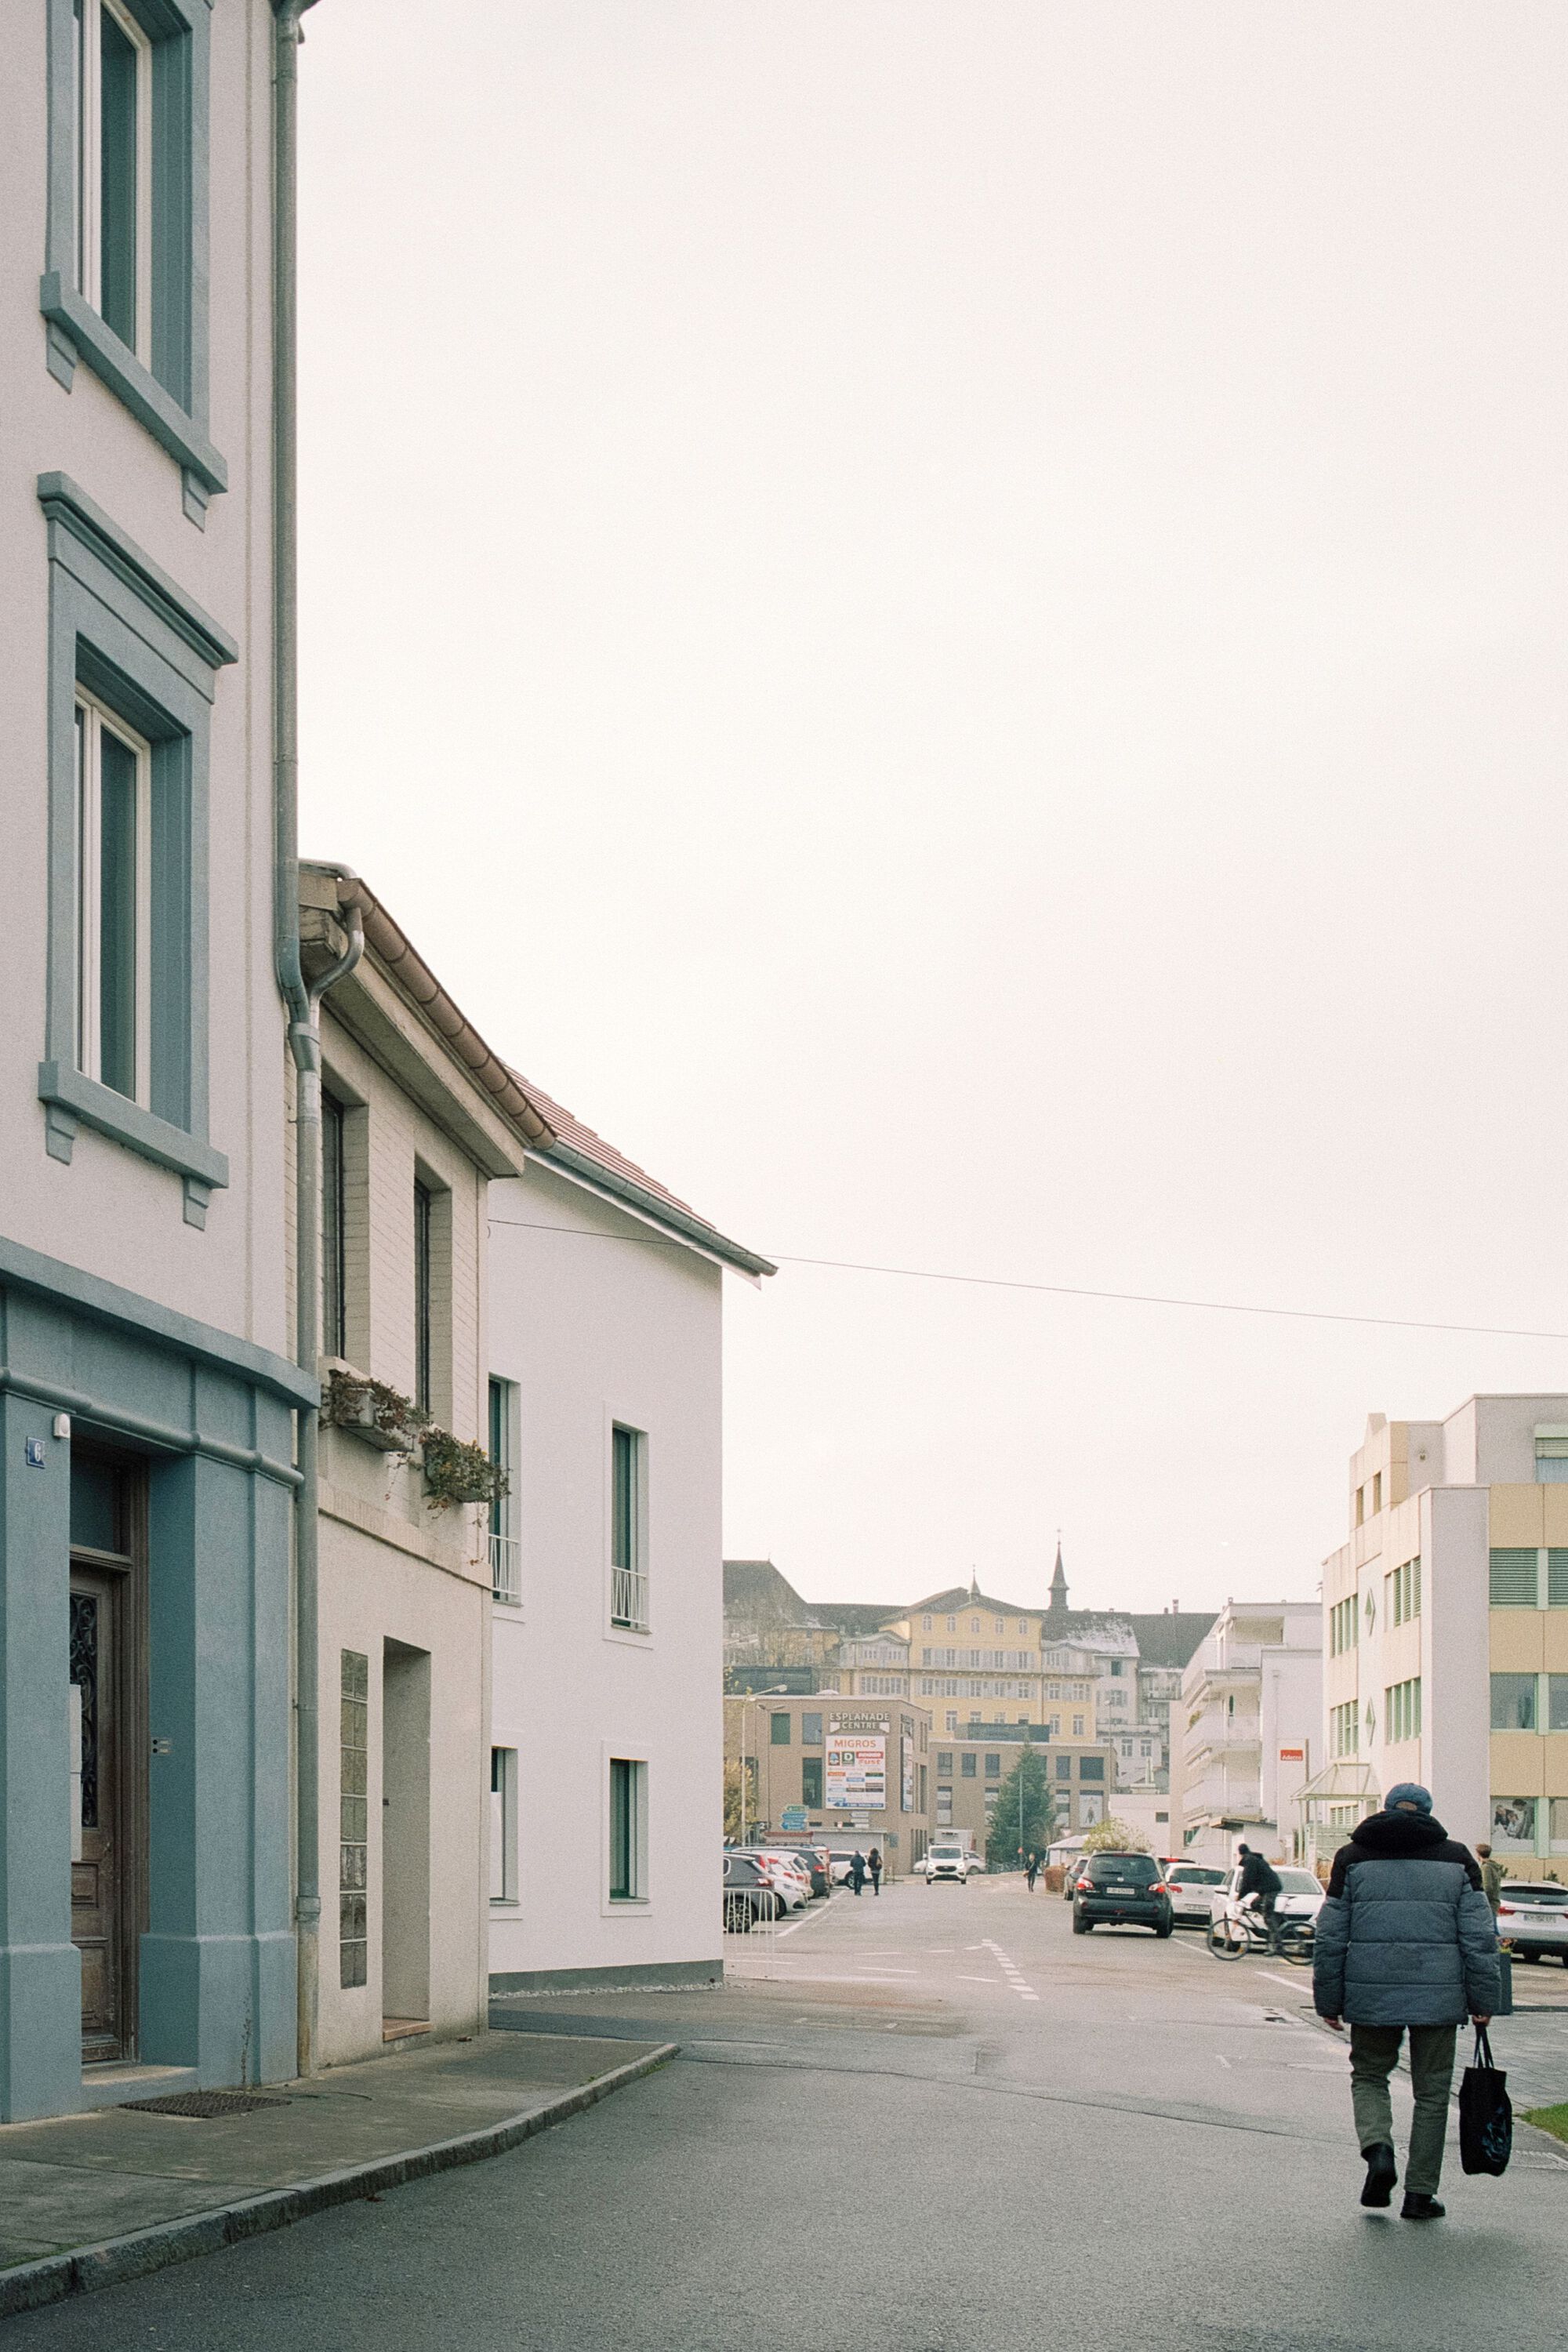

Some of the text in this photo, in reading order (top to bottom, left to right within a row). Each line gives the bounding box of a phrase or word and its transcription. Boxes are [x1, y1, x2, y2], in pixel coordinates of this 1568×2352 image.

[34, 1443, 41, 1462] 6
[829, 1712, 890, 1721] ESPLANADE
[834, 1739, 877, 1748] MIGROS
